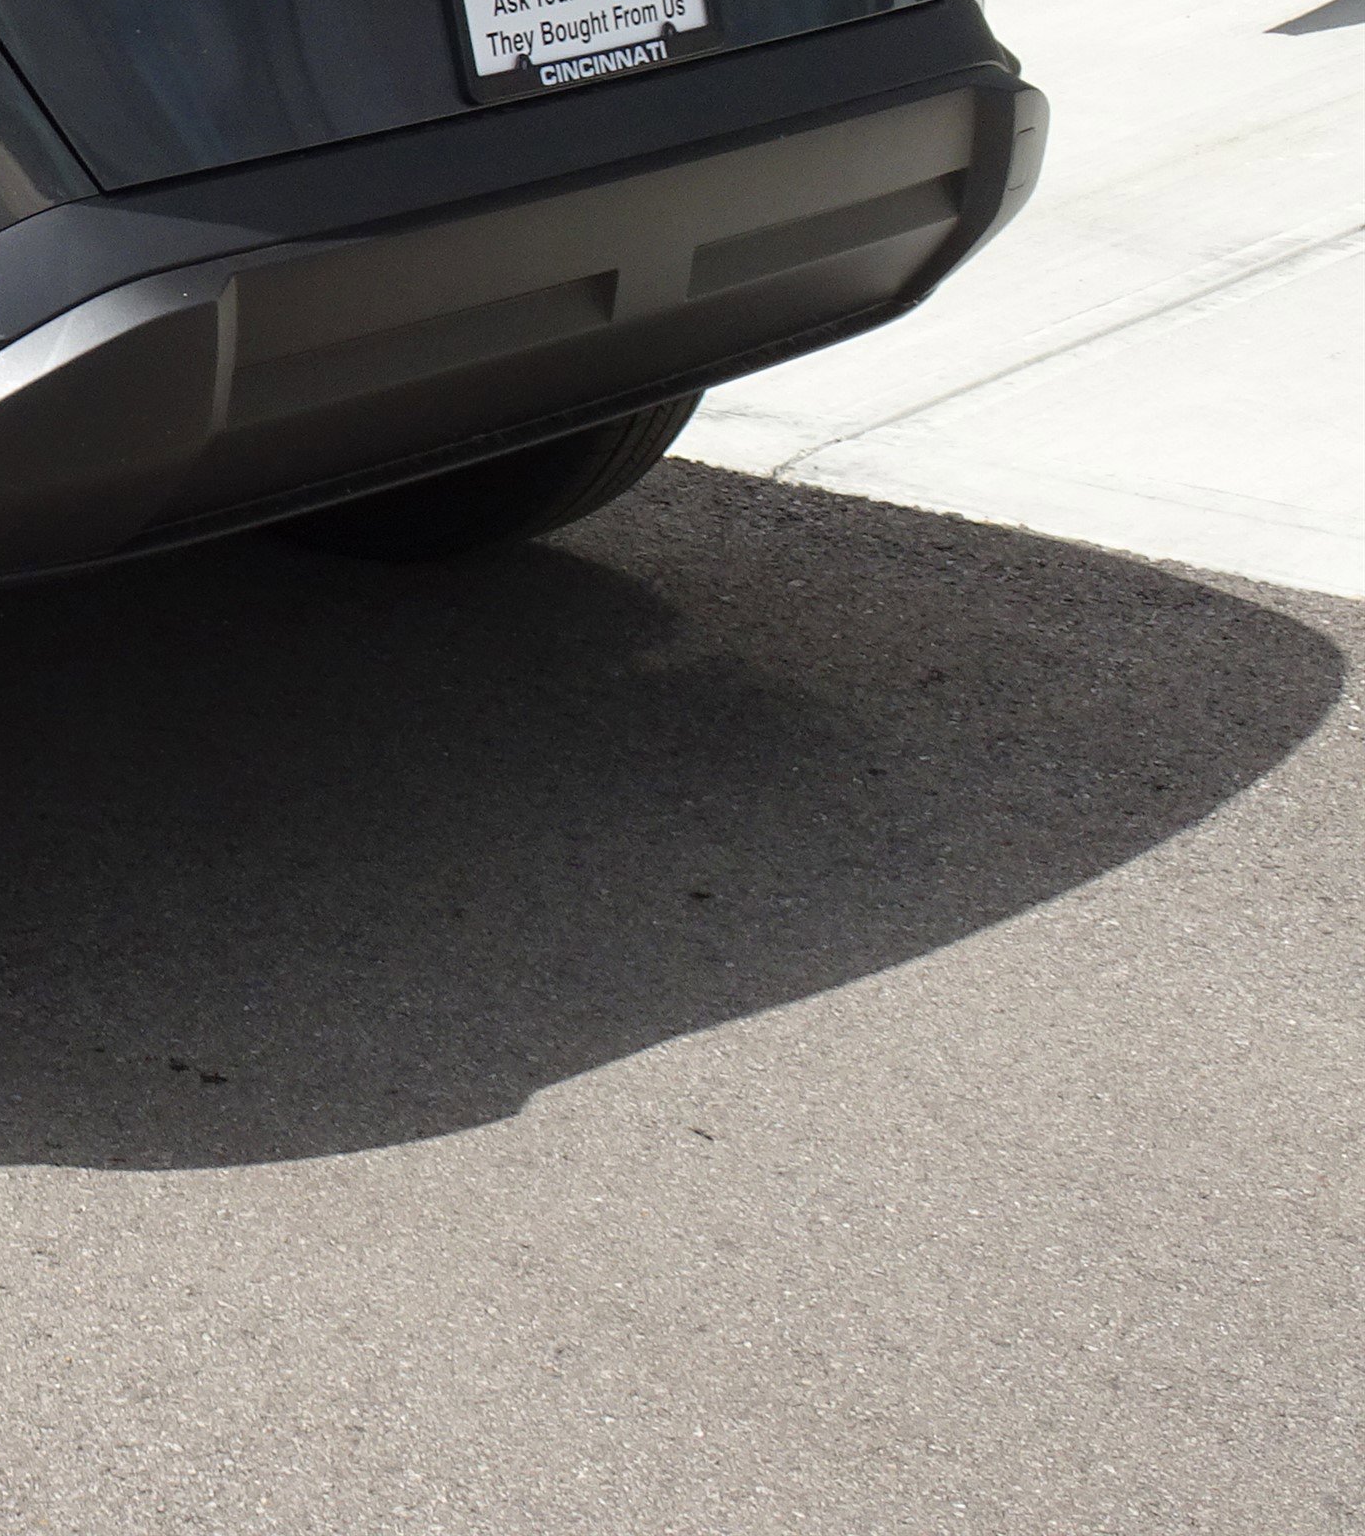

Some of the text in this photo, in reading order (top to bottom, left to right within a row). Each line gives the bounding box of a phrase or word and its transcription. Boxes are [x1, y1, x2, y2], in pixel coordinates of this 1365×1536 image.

[486, 28, 534, 57] They
[540, 10, 610, 44] Bought
[612, 3, 658, 30] From
[539, 40, 668, 86] CINCINNATI
